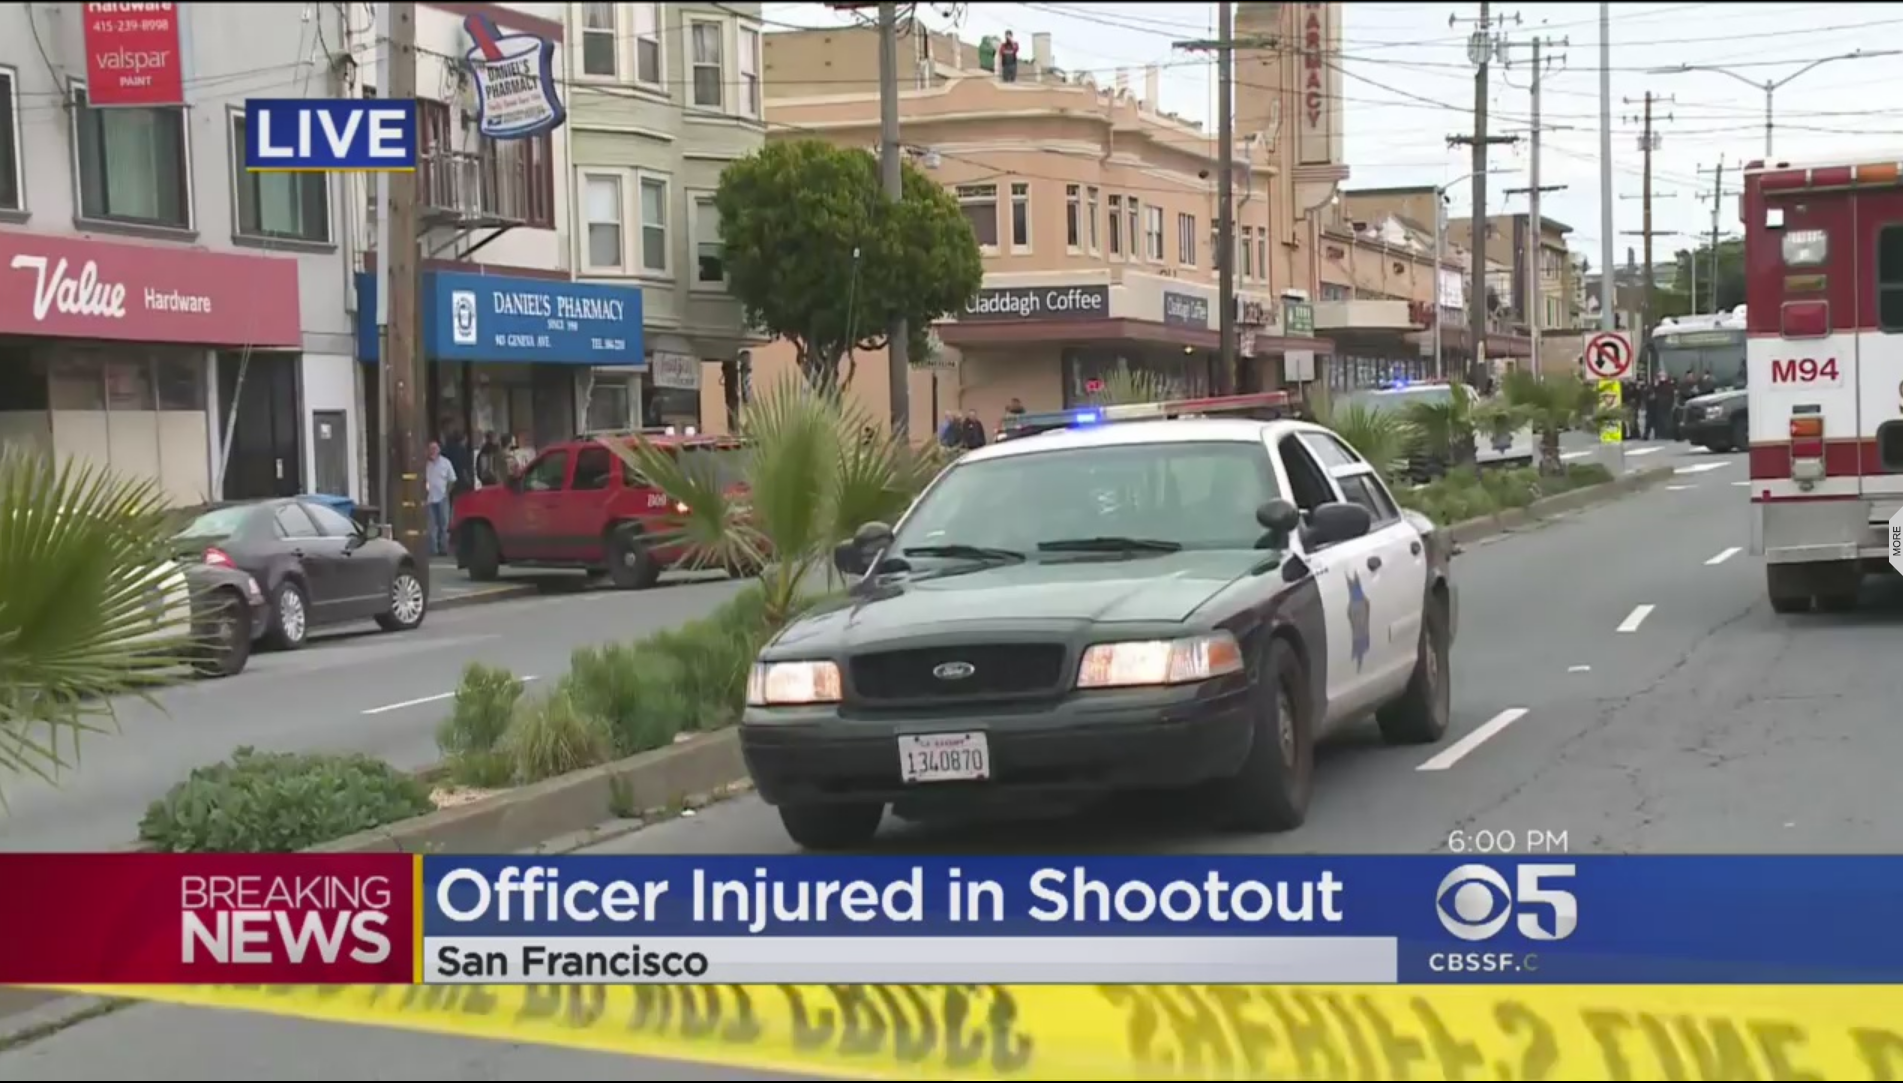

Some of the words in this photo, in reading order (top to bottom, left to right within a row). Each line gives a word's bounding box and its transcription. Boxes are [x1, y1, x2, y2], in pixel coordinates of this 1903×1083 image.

[95, 44, 171, 73] valspar
[487, 58, 531, 81] DANIEL'S
[119, 75, 152, 87] PAINT
[486, 75, 538, 100] PHARMACY
[11, 254, 127, 321] Value
[144, 286, 212, 314] Hardware
[493, 291, 551, 317] DANIEL'S
[556, 295, 625, 322] PHARMACY
[965, 290, 1041, 317] Claddagh
[1046, 288, 1102, 311] Coffee
[507, 335, 535, 348] GENEVA
[1771, 357, 1840, 384] M94
[907, 747, 984, 775] 1340870
